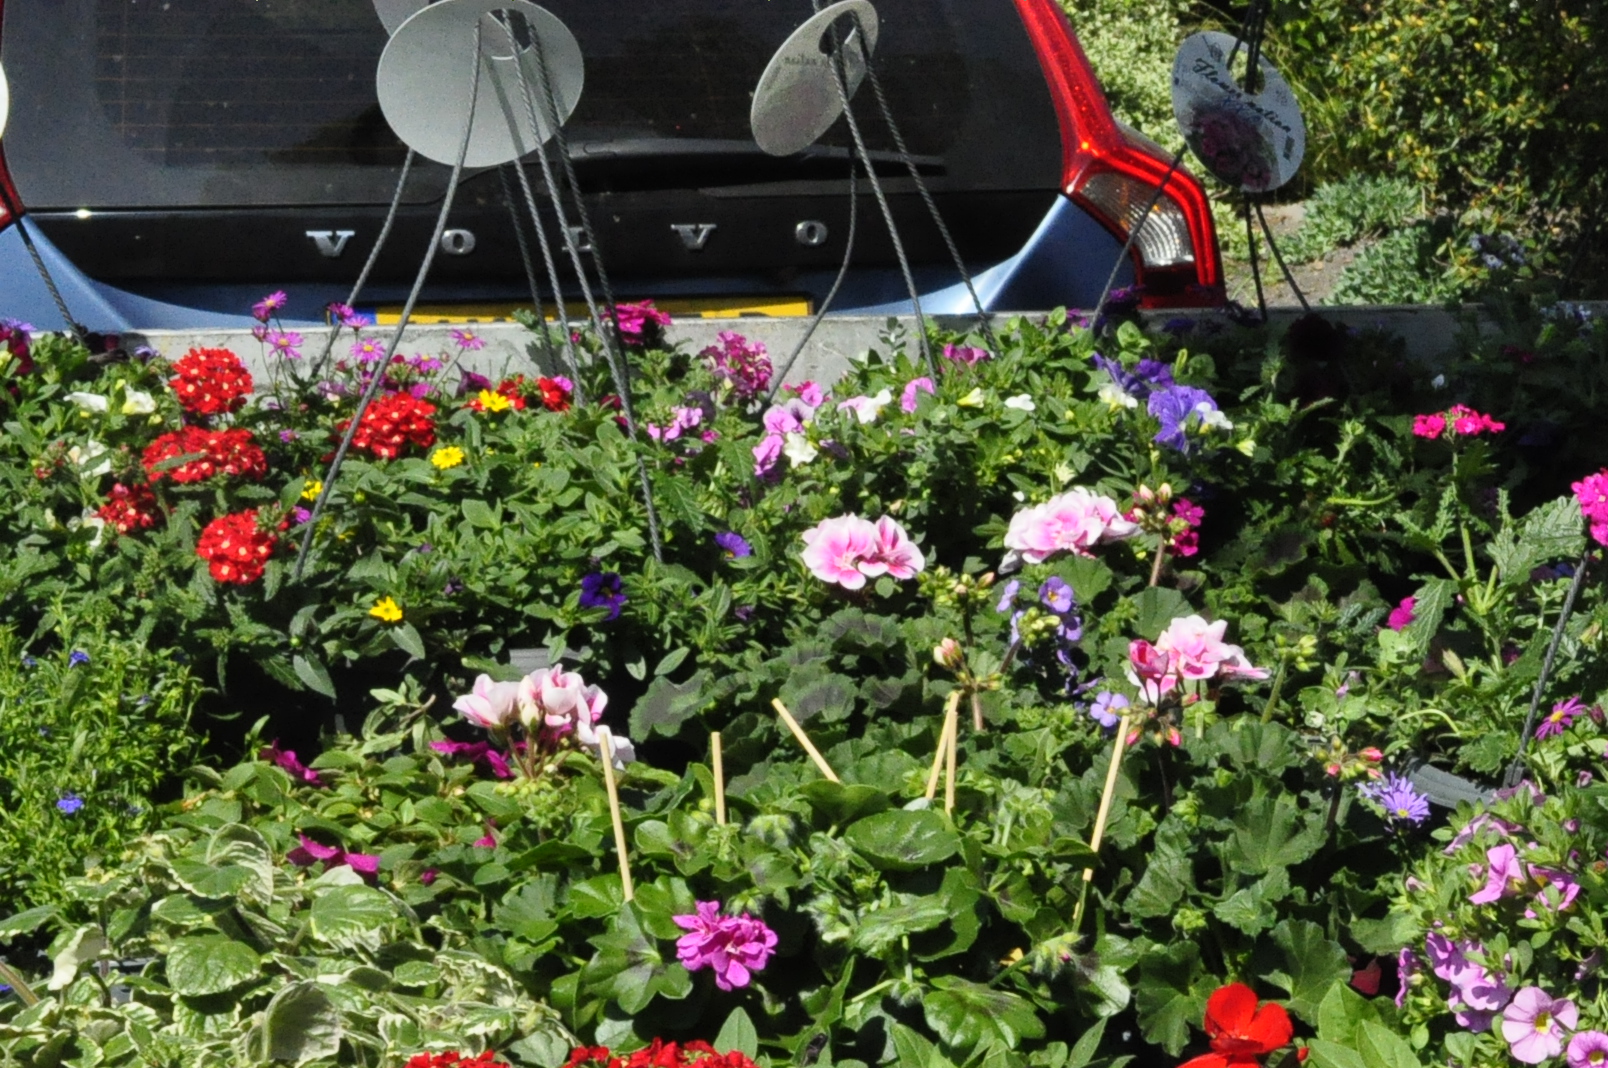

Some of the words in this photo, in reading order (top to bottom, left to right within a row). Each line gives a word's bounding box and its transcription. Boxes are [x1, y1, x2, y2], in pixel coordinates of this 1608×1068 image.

[1192, 57, 1243, 99] Flower
[1245, 101, 1292, 133] nation
[305, 219, 829, 258] VOLVO
